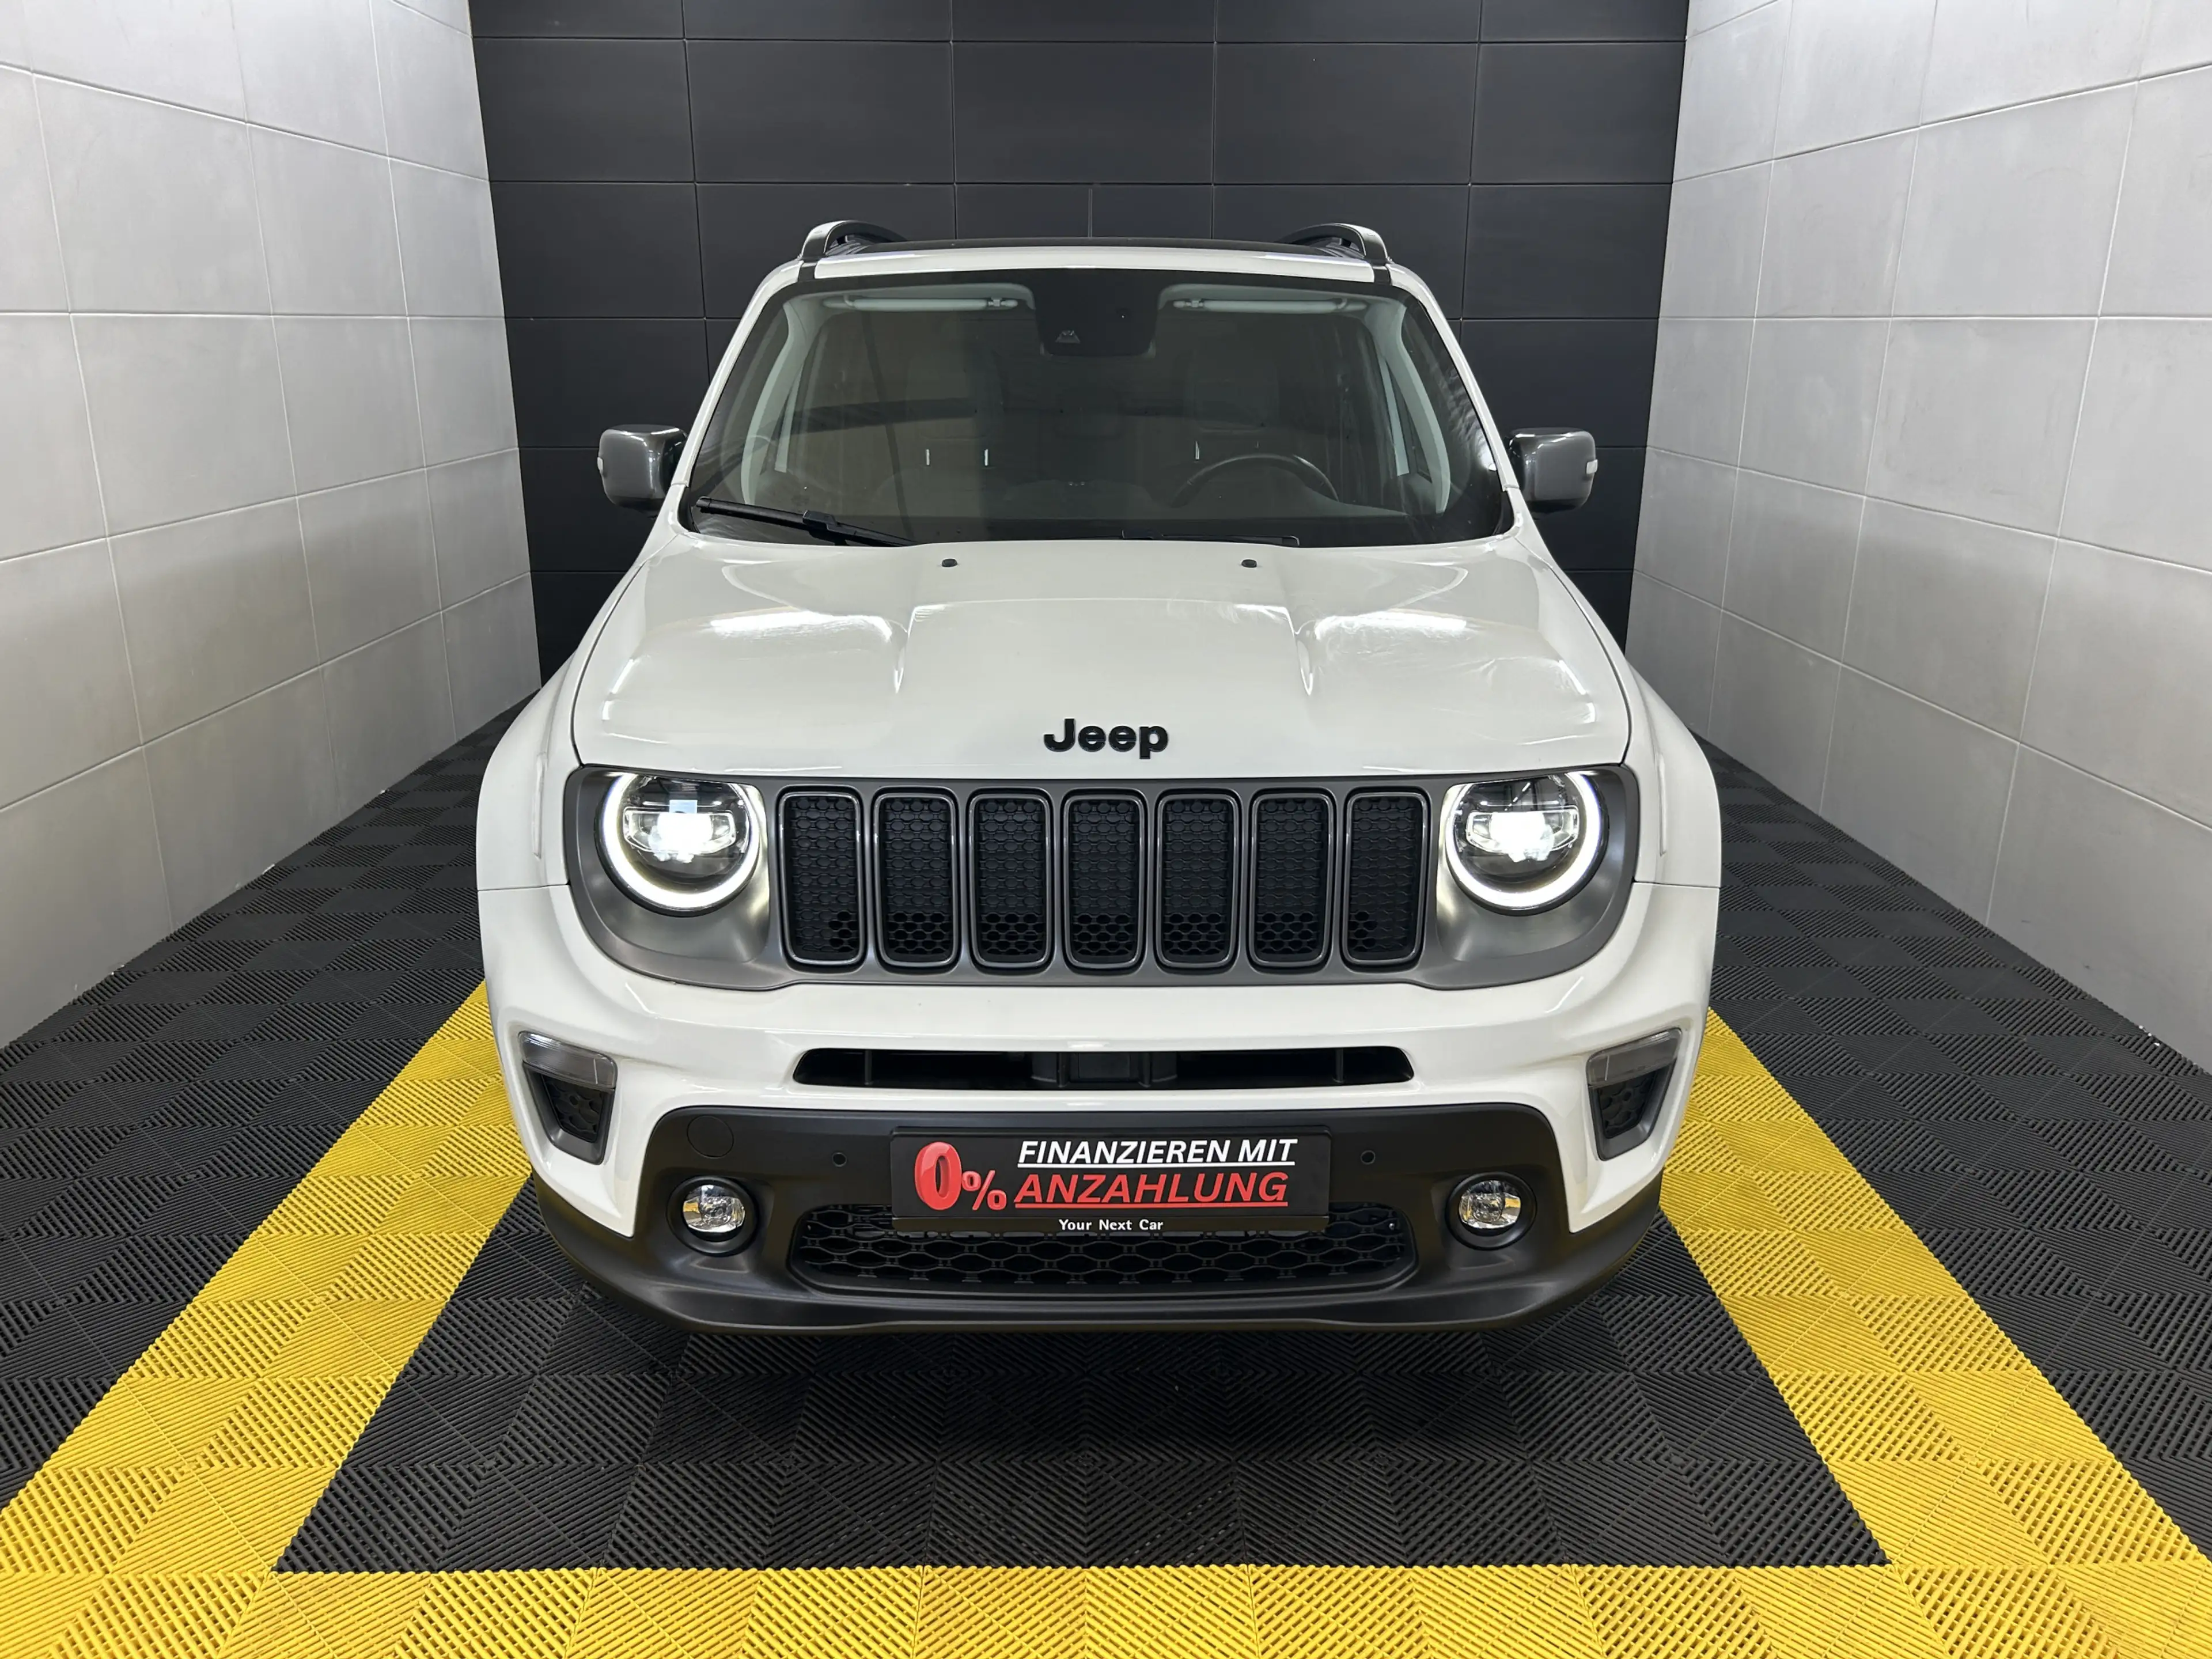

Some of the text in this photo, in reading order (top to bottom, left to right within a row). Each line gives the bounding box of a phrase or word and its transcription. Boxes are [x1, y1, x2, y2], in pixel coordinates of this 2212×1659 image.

[1043, 718, 1169, 760] Jeep
[1018, 1138, 1298, 1164] FINANZIEREN MIT
[914, 1141, 1007, 1211] 0%
[1013, 1172, 1289, 1203] ANZAHLUNG
[1059, 1219, 1164, 1231] Your Next Car
